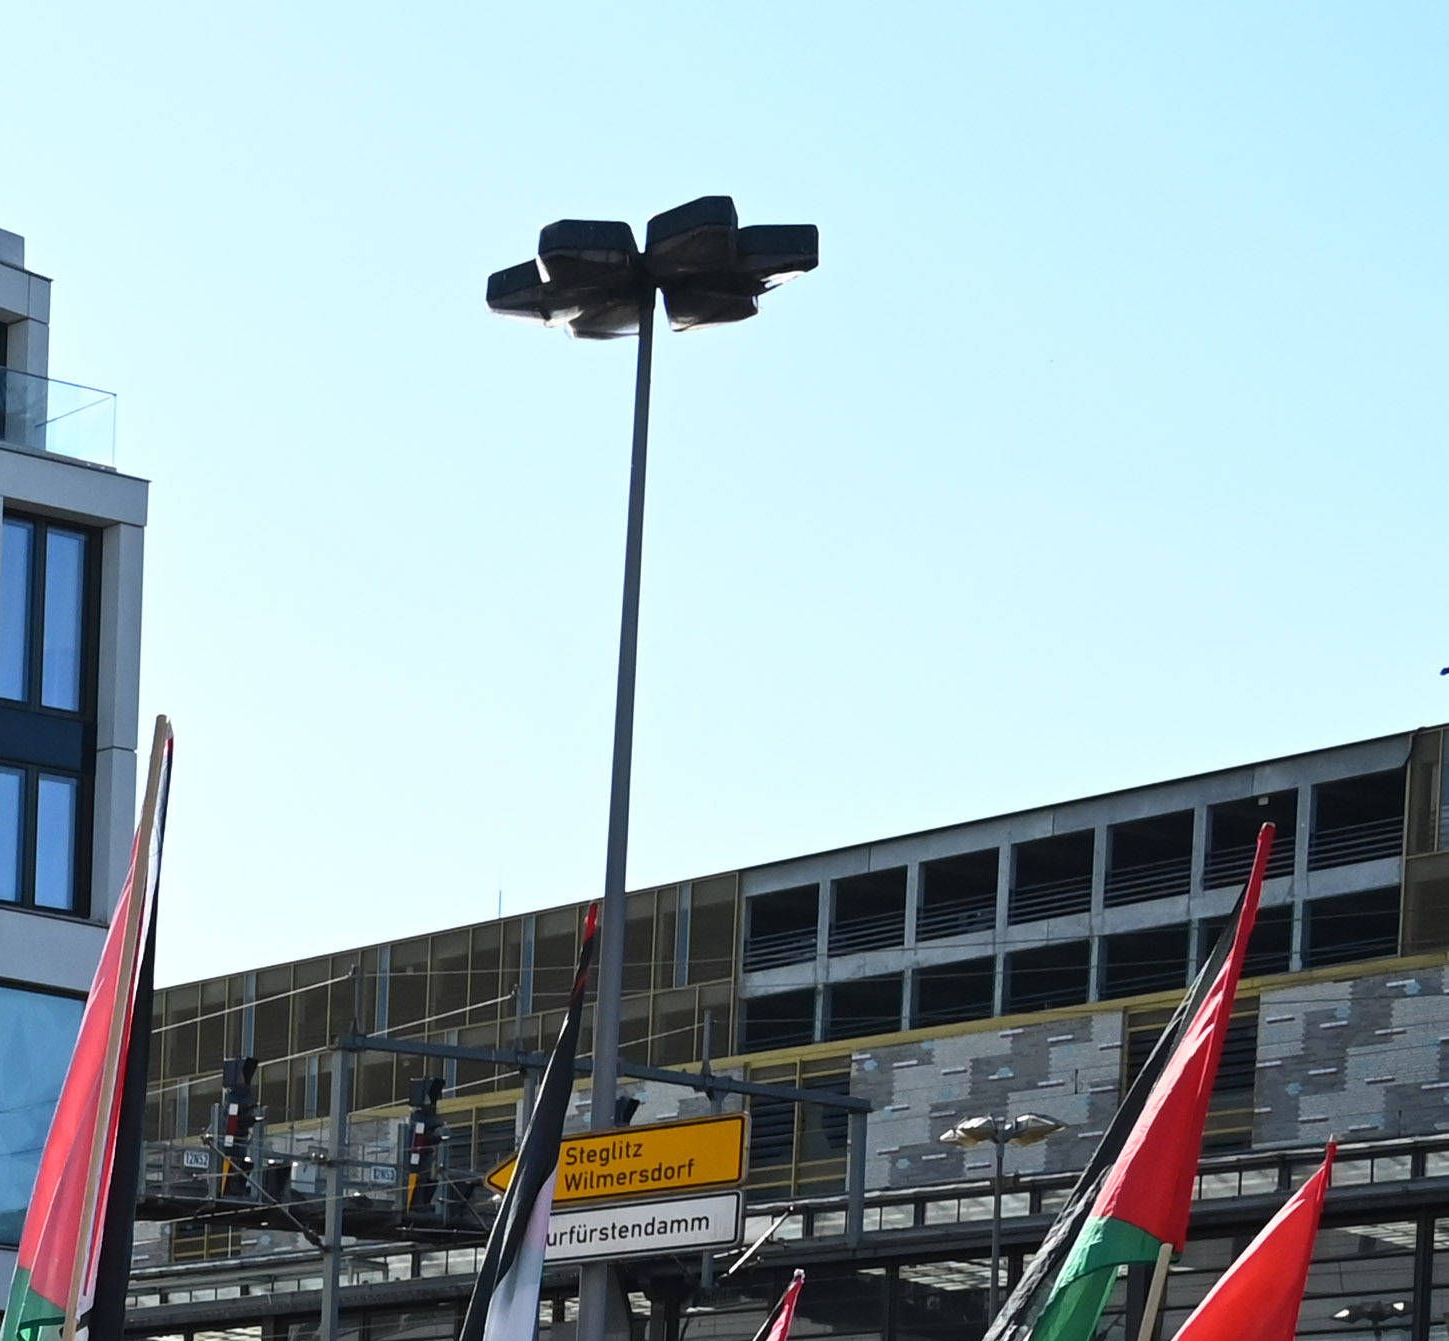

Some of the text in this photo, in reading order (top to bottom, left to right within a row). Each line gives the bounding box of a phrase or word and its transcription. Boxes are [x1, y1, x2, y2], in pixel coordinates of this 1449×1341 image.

[565, 1141, 644, 1171] Steglitz
[564, 1158, 698, 1191] Wilmersdorf
[547, 1213, 711, 1248] urfürstendamm
